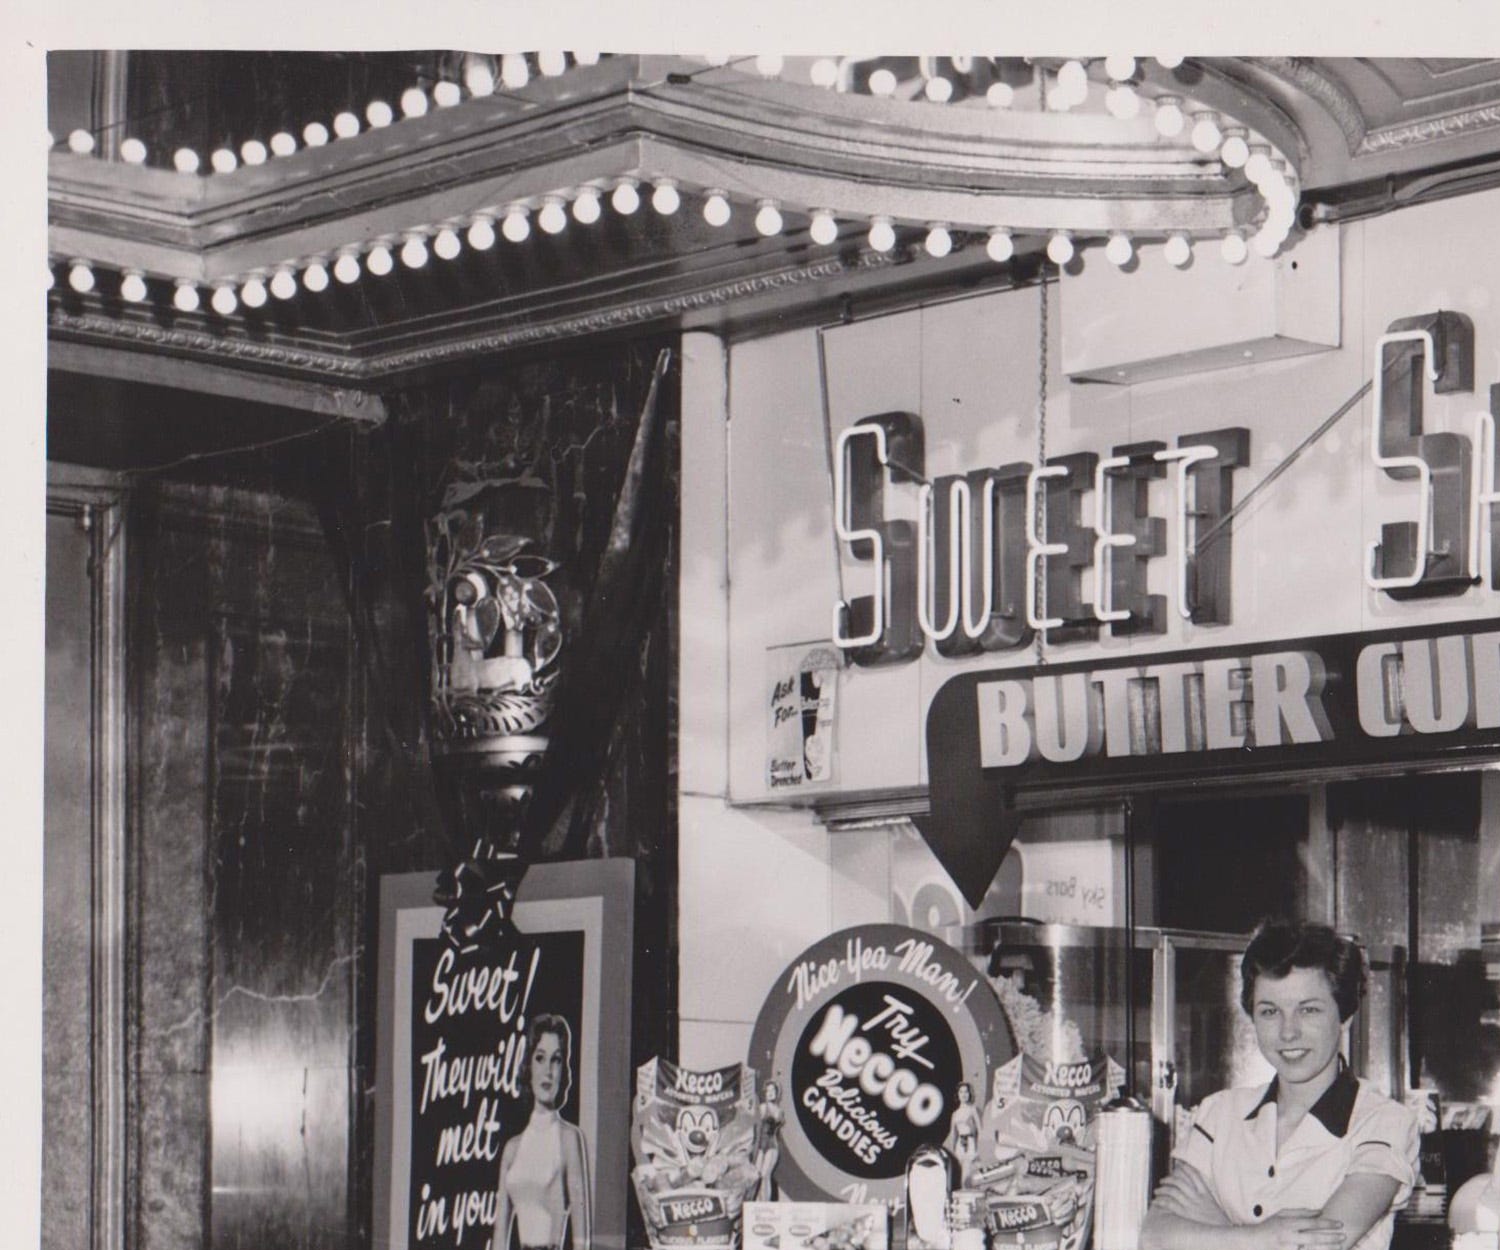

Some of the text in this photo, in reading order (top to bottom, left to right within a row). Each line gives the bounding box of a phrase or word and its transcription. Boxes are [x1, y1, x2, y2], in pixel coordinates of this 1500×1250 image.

[833, 410, 1250, 668] SWEET
[977, 650, 1334, 768] BUTTER
[424, 946, 541, 1031] Sweet!
[895, 938, 979, 1013] Man!
[809, 1003, 944, 1127] Necco
[861, 994, 934, 1069] Try
[420, 1036, 474, 1115] They
[676, 1069, 722, 1094] Necco
[816, 1068, 898, 1150] Delicious
[1044, 1062, 1092, 1087] Necco
[436, 1098, 501, 1167] melt
[803, 1086, 882, 1165] CANDIES
[416, 1183, 448, 1242] in
[672, 1199, 714, 1222] Necco
[1000, 1206, 1038, 1227] Necco
